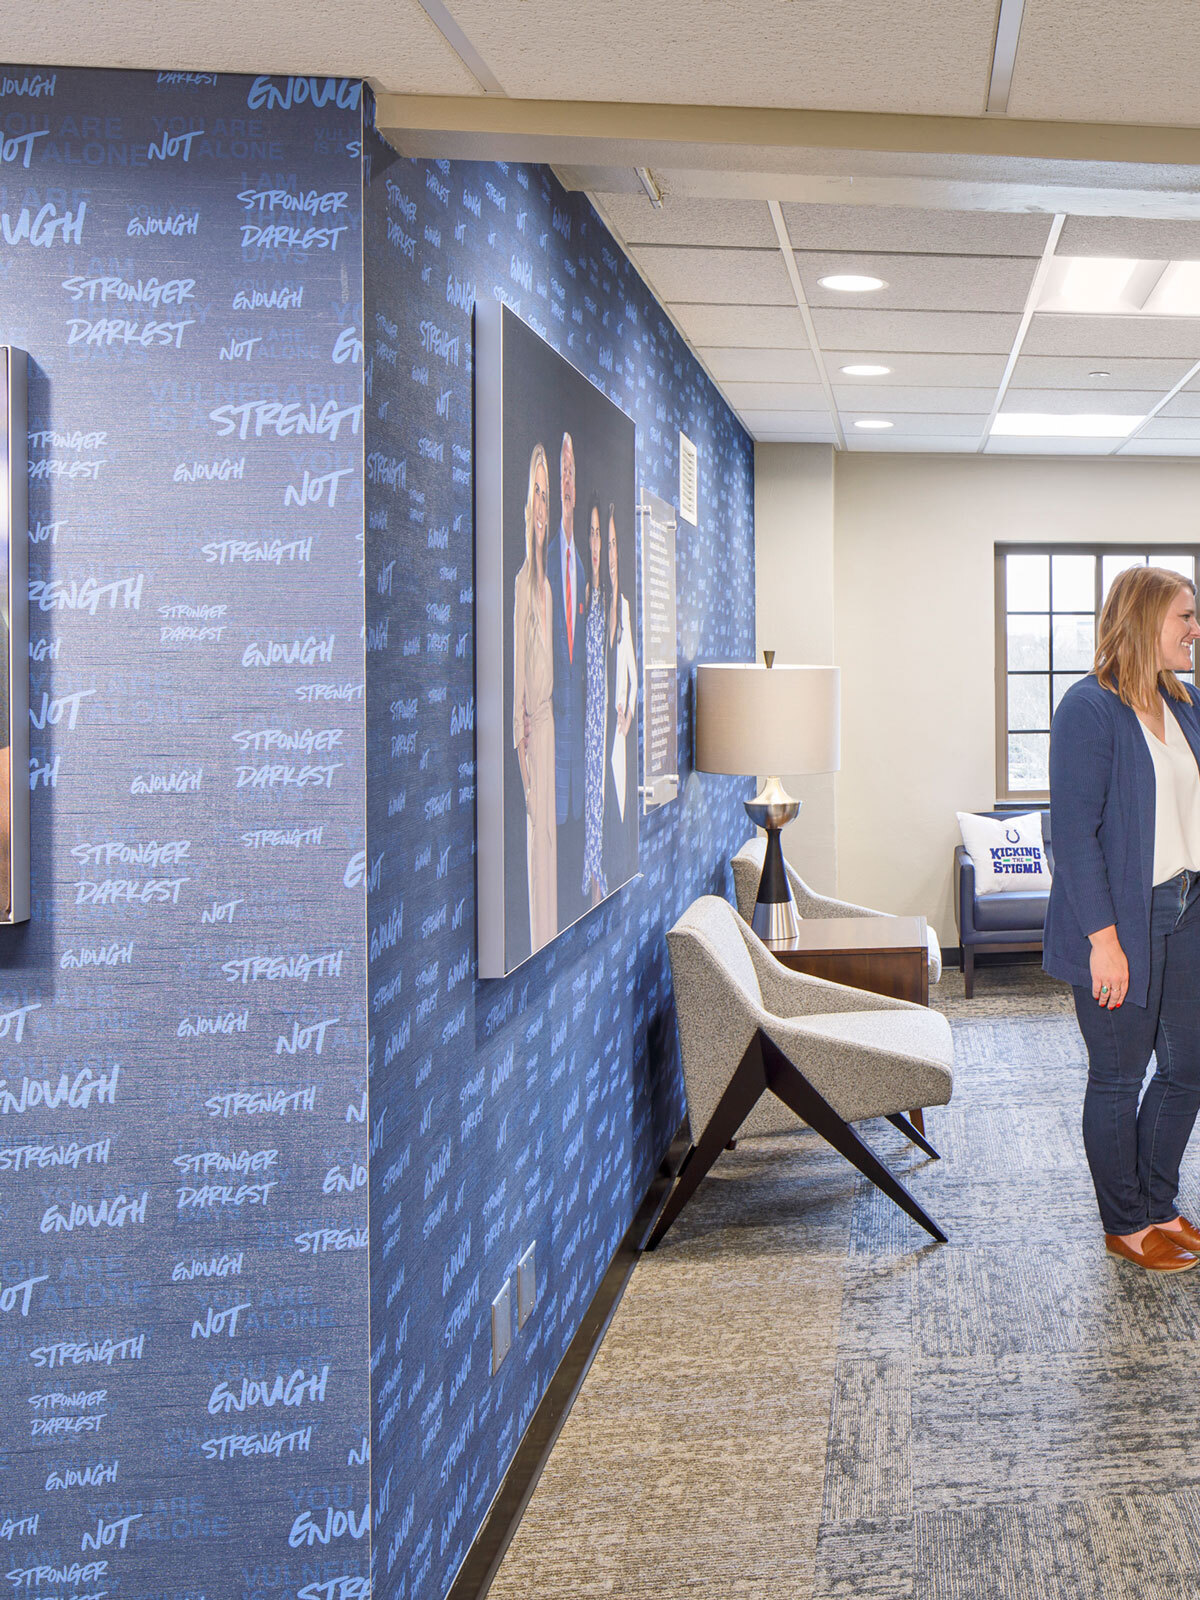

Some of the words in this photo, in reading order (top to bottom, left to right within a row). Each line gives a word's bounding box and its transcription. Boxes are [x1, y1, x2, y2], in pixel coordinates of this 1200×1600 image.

[148, 131, 204, 162] NOT
[236, 190, 348, 215] STRONGER
[126, 213, 199, 236] ENOUGH
[240, 226, 348, 250] DARKEST
[61, 276, 196, 307] STRONGER
[232, 286, 304, 310] ENOUGH
[66, 319, 196, 348] DARKEST
[219, 337, 262, 361] NOT
[173, 458, 245, 482] ENOUGH
[285, 469, 354, 507] NOT
[201, 537, 313, 564] STRENGTH
[158, 605, 228, 620] STRONGER
[160, 626, 228, 642] DARKEST
[242, 634, 335, 667] ENOUGH
[231, 728, 343, 755] STRONGER
[130, 769, 203, 794] ENOUGH
[236, 763, 344, 789] DARKEST
[240, 826, 323, 848] STRENGTH
[71, 841, 191, 867] STRONGER
[990, 847, 1041, 860] KICKING
[993, 861, 1042, 874] STIGMA
[74, 877, 191, 904] DARKEST
[201, 899, 245, 924] NOT
[60, 942, 134, 969] ENOUGH
[221, 950, 343, 983] STRENGTH
[177, 1011, 249, 1038] ENOUGH
[276, 1018, 340, 1055] NOT
[205, 1086, 316, 1118] STRENGTH
[0, 1138, 111, 1171] STRENGTH
[172, 1149, 279, 1175] STRONGER
[176, 1182, 279, 1208] DARKEST
[40, 1192, 148, 1234] ENOUGH
[172, 1254, 244, 1281] ENOUGH
[191, 1303, 252, 1339] NOT
[30, 1334, 145, 1368] STRENGTH
[28, 1390, 108, 1410] STRONGER
[207, 1366, 329, 1415] ENOUGH
[30, 1414, 108, 1436] DARKEST
[201, 1426, 312, 1460] STRENGTH
[45, 1461, 119, 1491] ENOUGH
[81, 1513, 143, 1551] NOT
[5, 1561, 108, 1587] STRONGER
